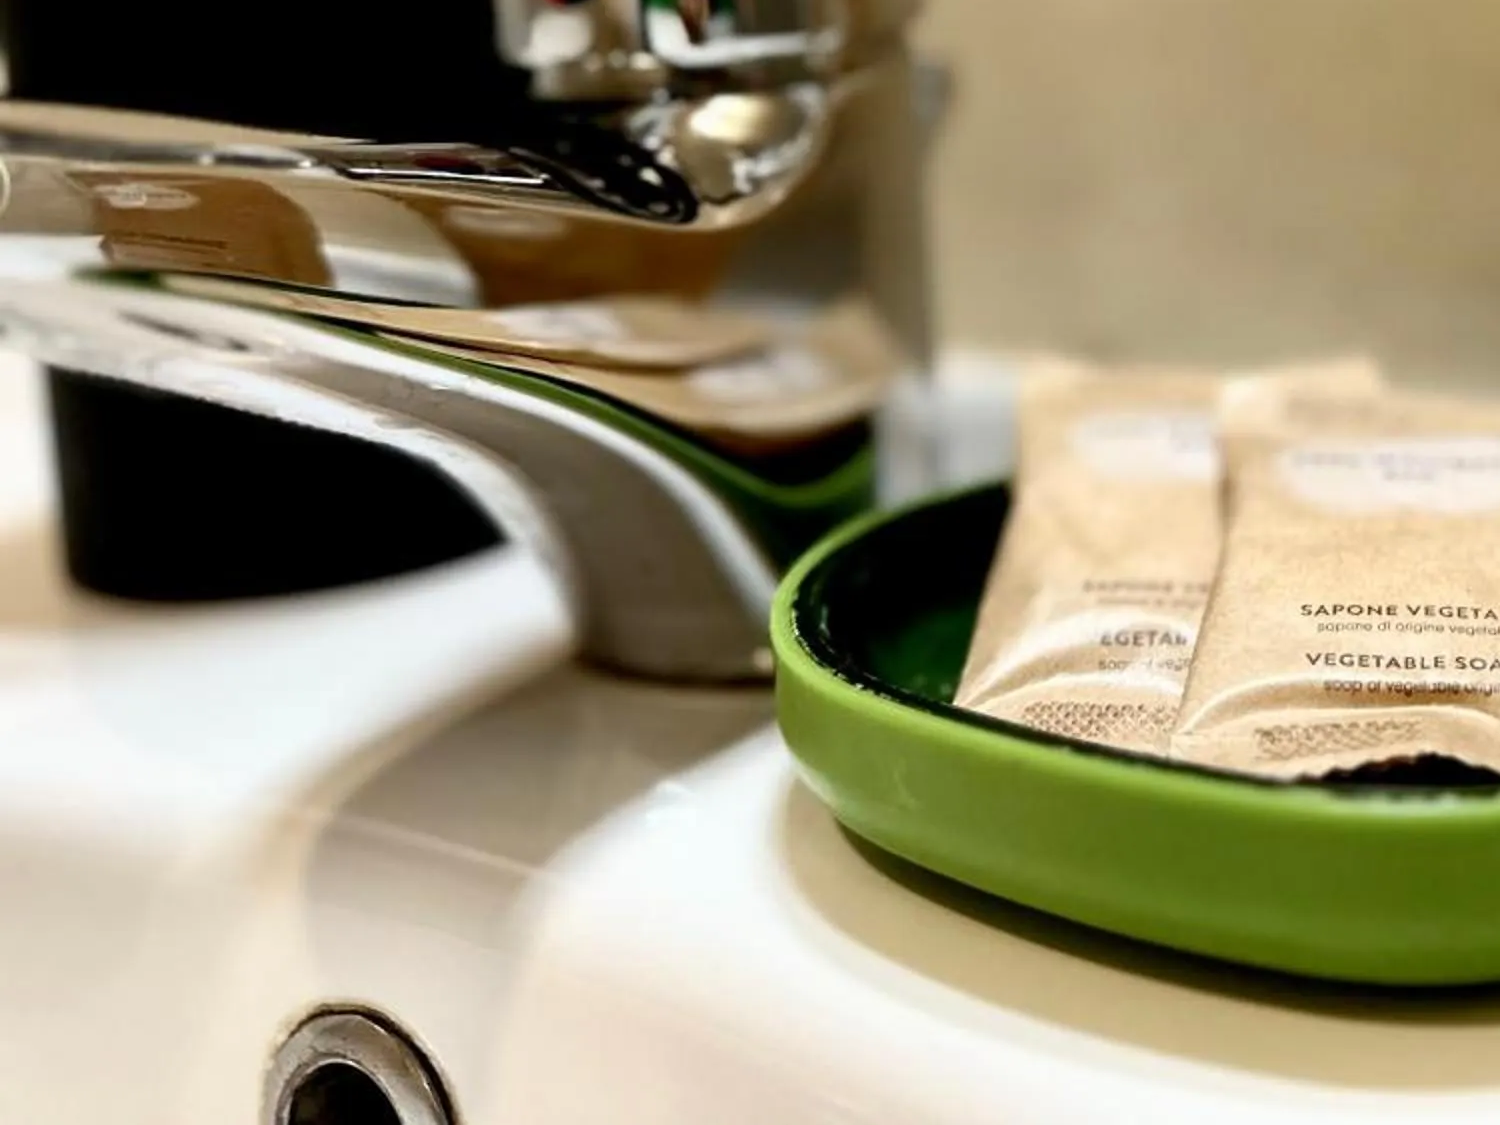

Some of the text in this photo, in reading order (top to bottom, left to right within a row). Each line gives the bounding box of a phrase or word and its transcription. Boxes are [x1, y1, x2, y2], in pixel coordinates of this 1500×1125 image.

[1300, 603, 1399, 618] SAPONE
[1316, 621, 1373, 634] sapone
[1376, 619, 1392, 631] di
[1395, 621, 1445, 635] origine
[1305, 652, 1446, 670] VEGETABLE
[1323, 679, 1364, 694] soap
